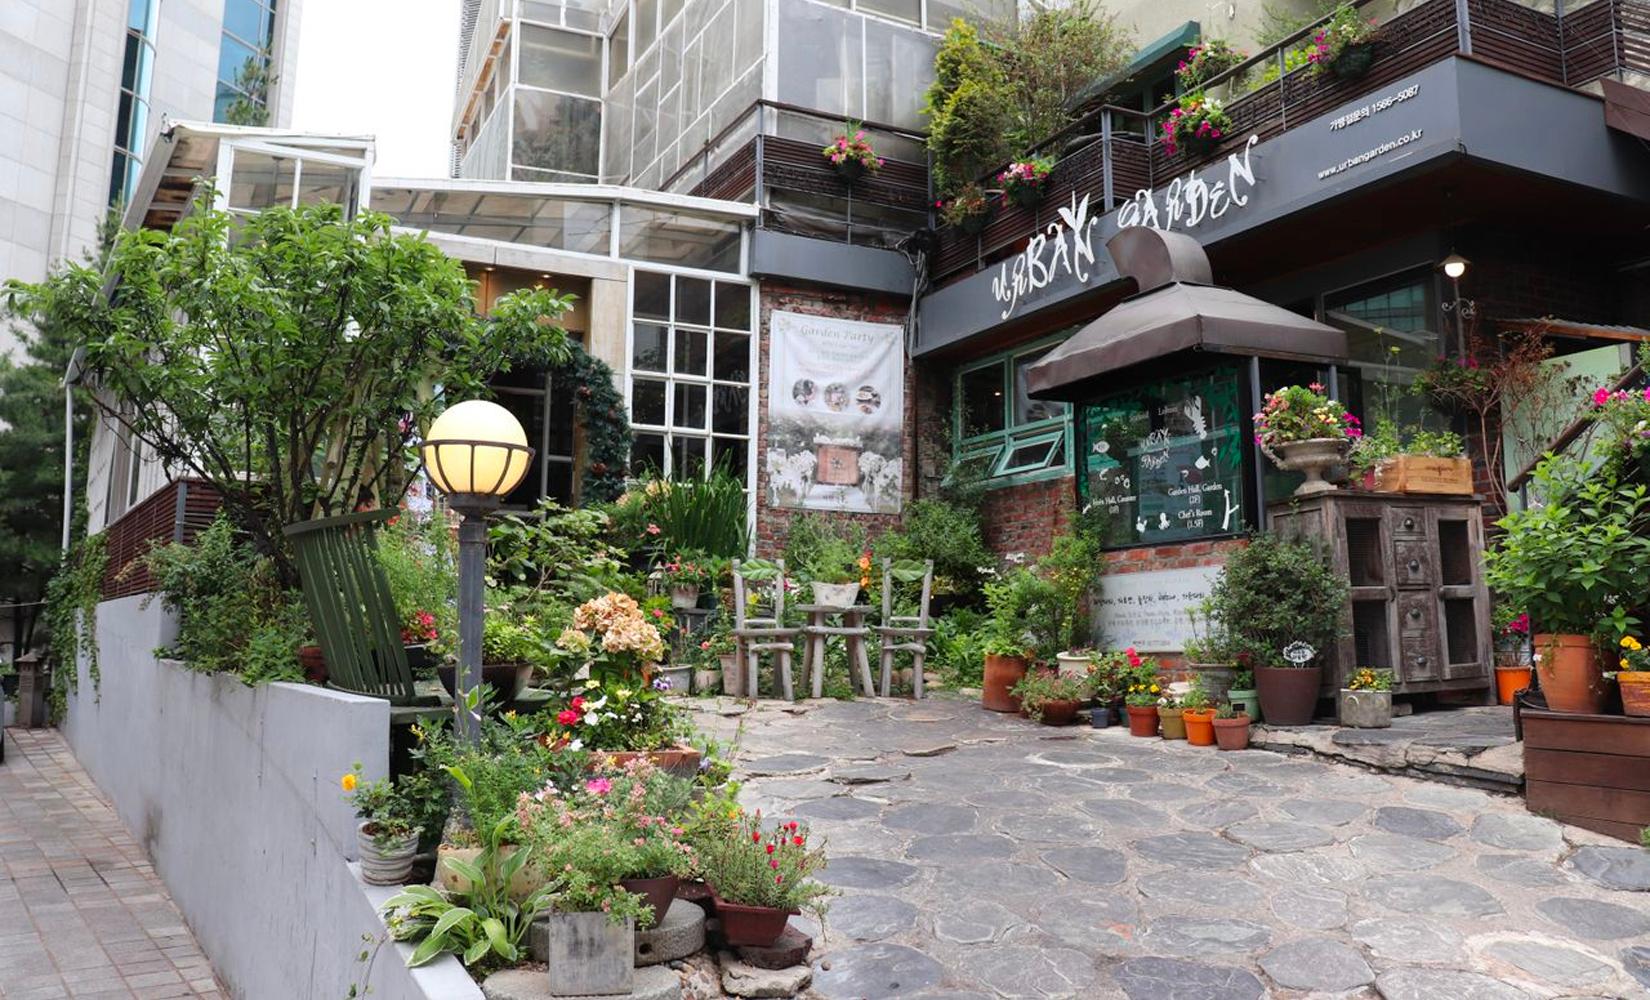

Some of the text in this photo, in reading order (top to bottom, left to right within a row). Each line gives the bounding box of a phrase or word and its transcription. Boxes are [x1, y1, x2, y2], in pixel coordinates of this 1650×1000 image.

[1330, 106, 1370, 131] 가맹점문의
[1317, 129, 1423, 179] www.urbangarden.co.kr
[992, 191, 1098, 320] URBAN
[801, 325, 840, 339] Garden
[843, 328, 874, 345] Party
[1167, 487, 1188, 497] Garden
[1201, 482, 1222, 491] Garden
[1196, 509, 1212, 517] Room
